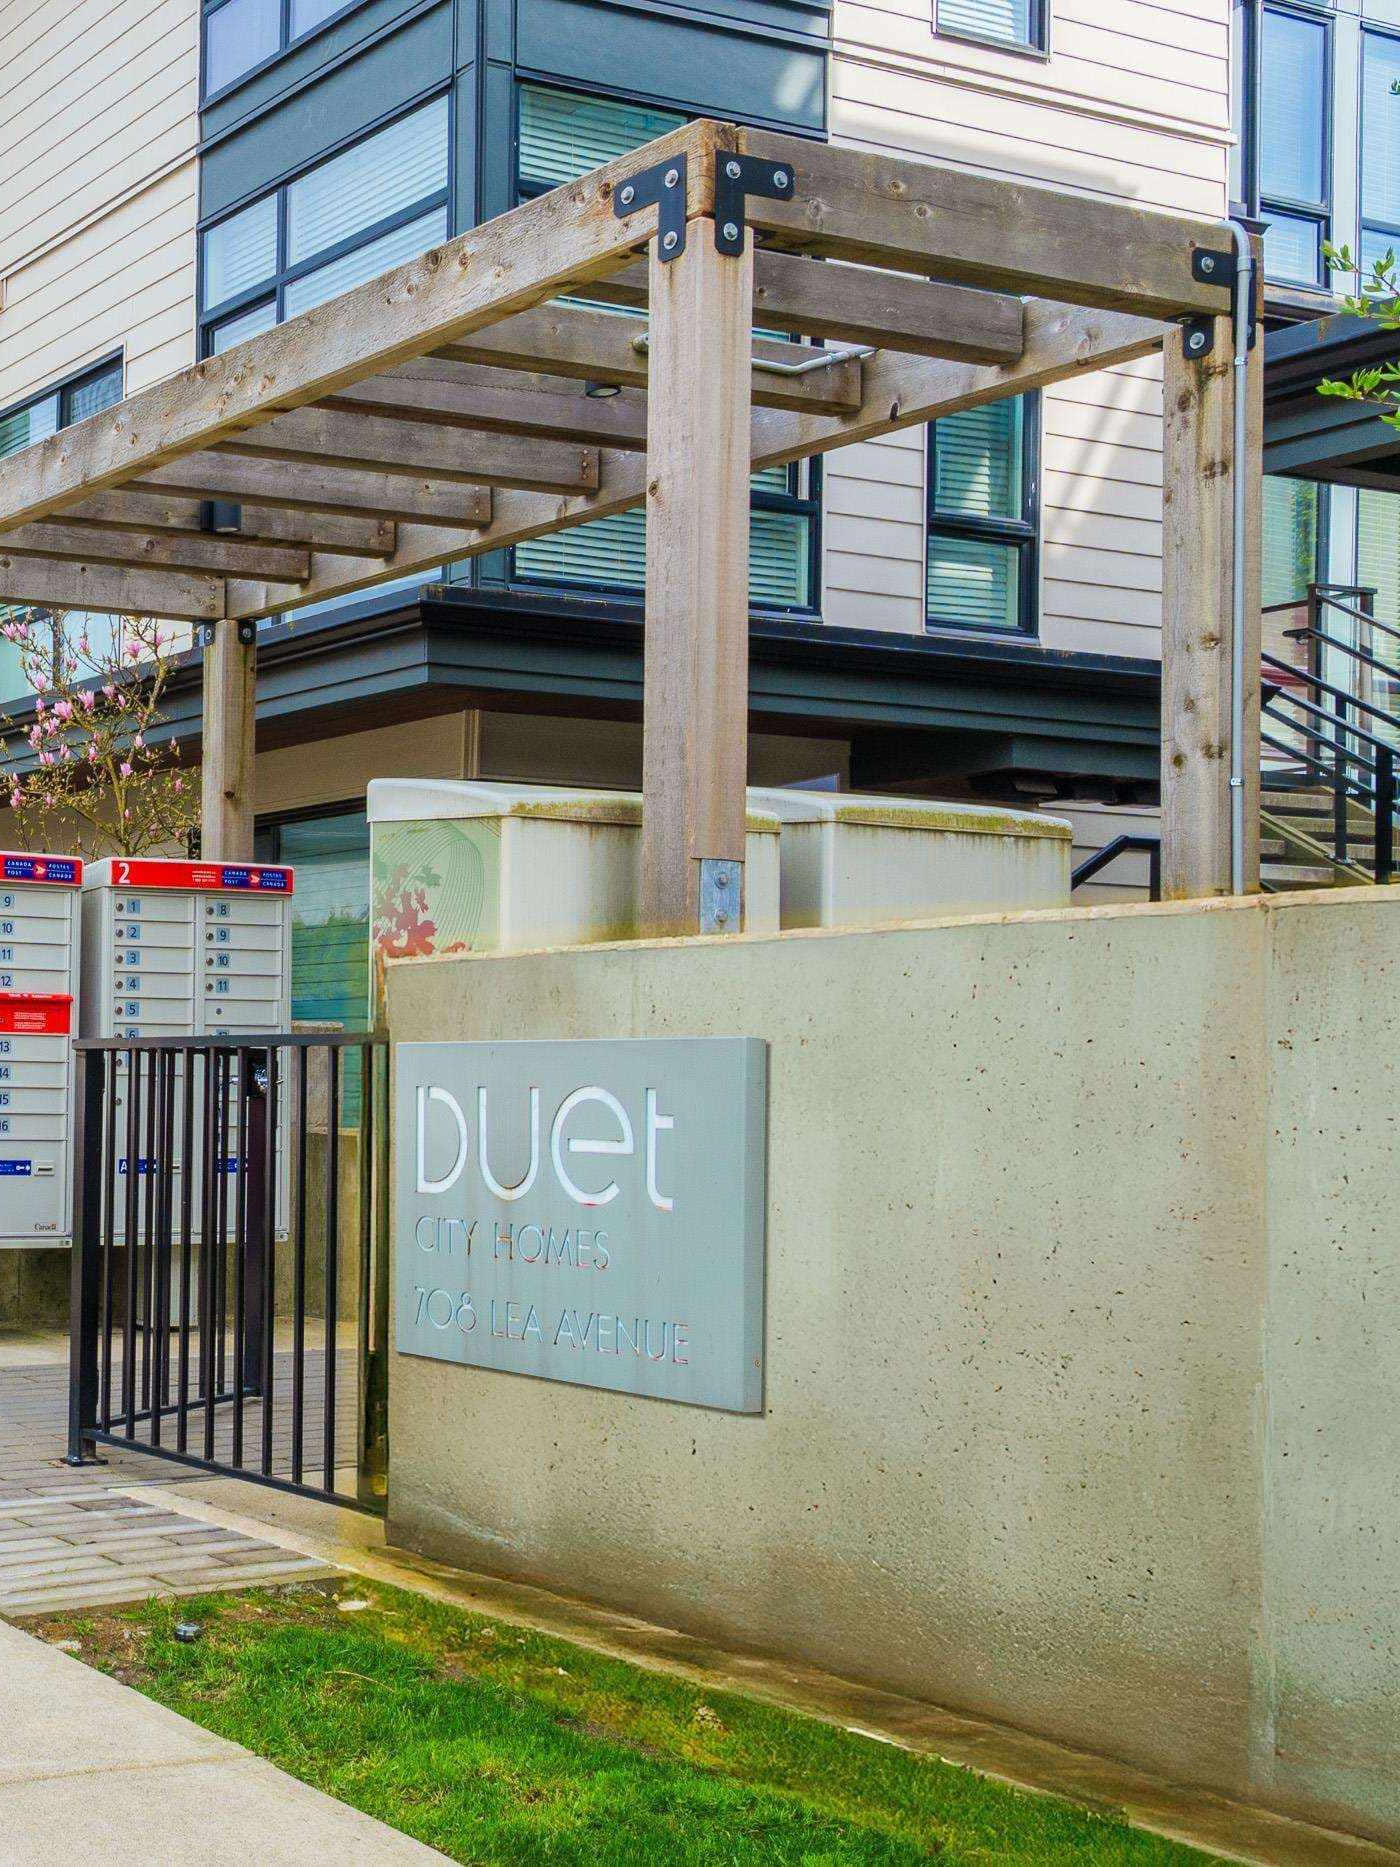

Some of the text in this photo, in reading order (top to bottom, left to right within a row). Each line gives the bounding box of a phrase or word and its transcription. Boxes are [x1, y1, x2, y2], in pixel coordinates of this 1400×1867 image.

[118, 863, 130, 884] 2
[262, 880, 284, 888] CANADA
[4, 896, 11, 907] 9
[131, 902, 136, 911] 1
[220, 905, 227, 915] 8
[2, 923, 13, 933] 10
[130, 927, 137, 938] 2
[220, 930, 227, 941] 9
[1, 949, 11, 960] 11
[130, 953, 136, 963] 3
[218, 955, 228, 966] 10
[1, 976, 11, 986] 12
[129, 979, 136, 989] 4
[218, 981, 227, 991] 11
[129, 1005, 135, 1015] 5
[0, 1041, 10, 1052] 13
[120, 1161, 127, 1173] A
[415, 1215, 611, 1271] CITY HOMES
[415, 1286, 690, 1365] 708 LEA AVENUE
